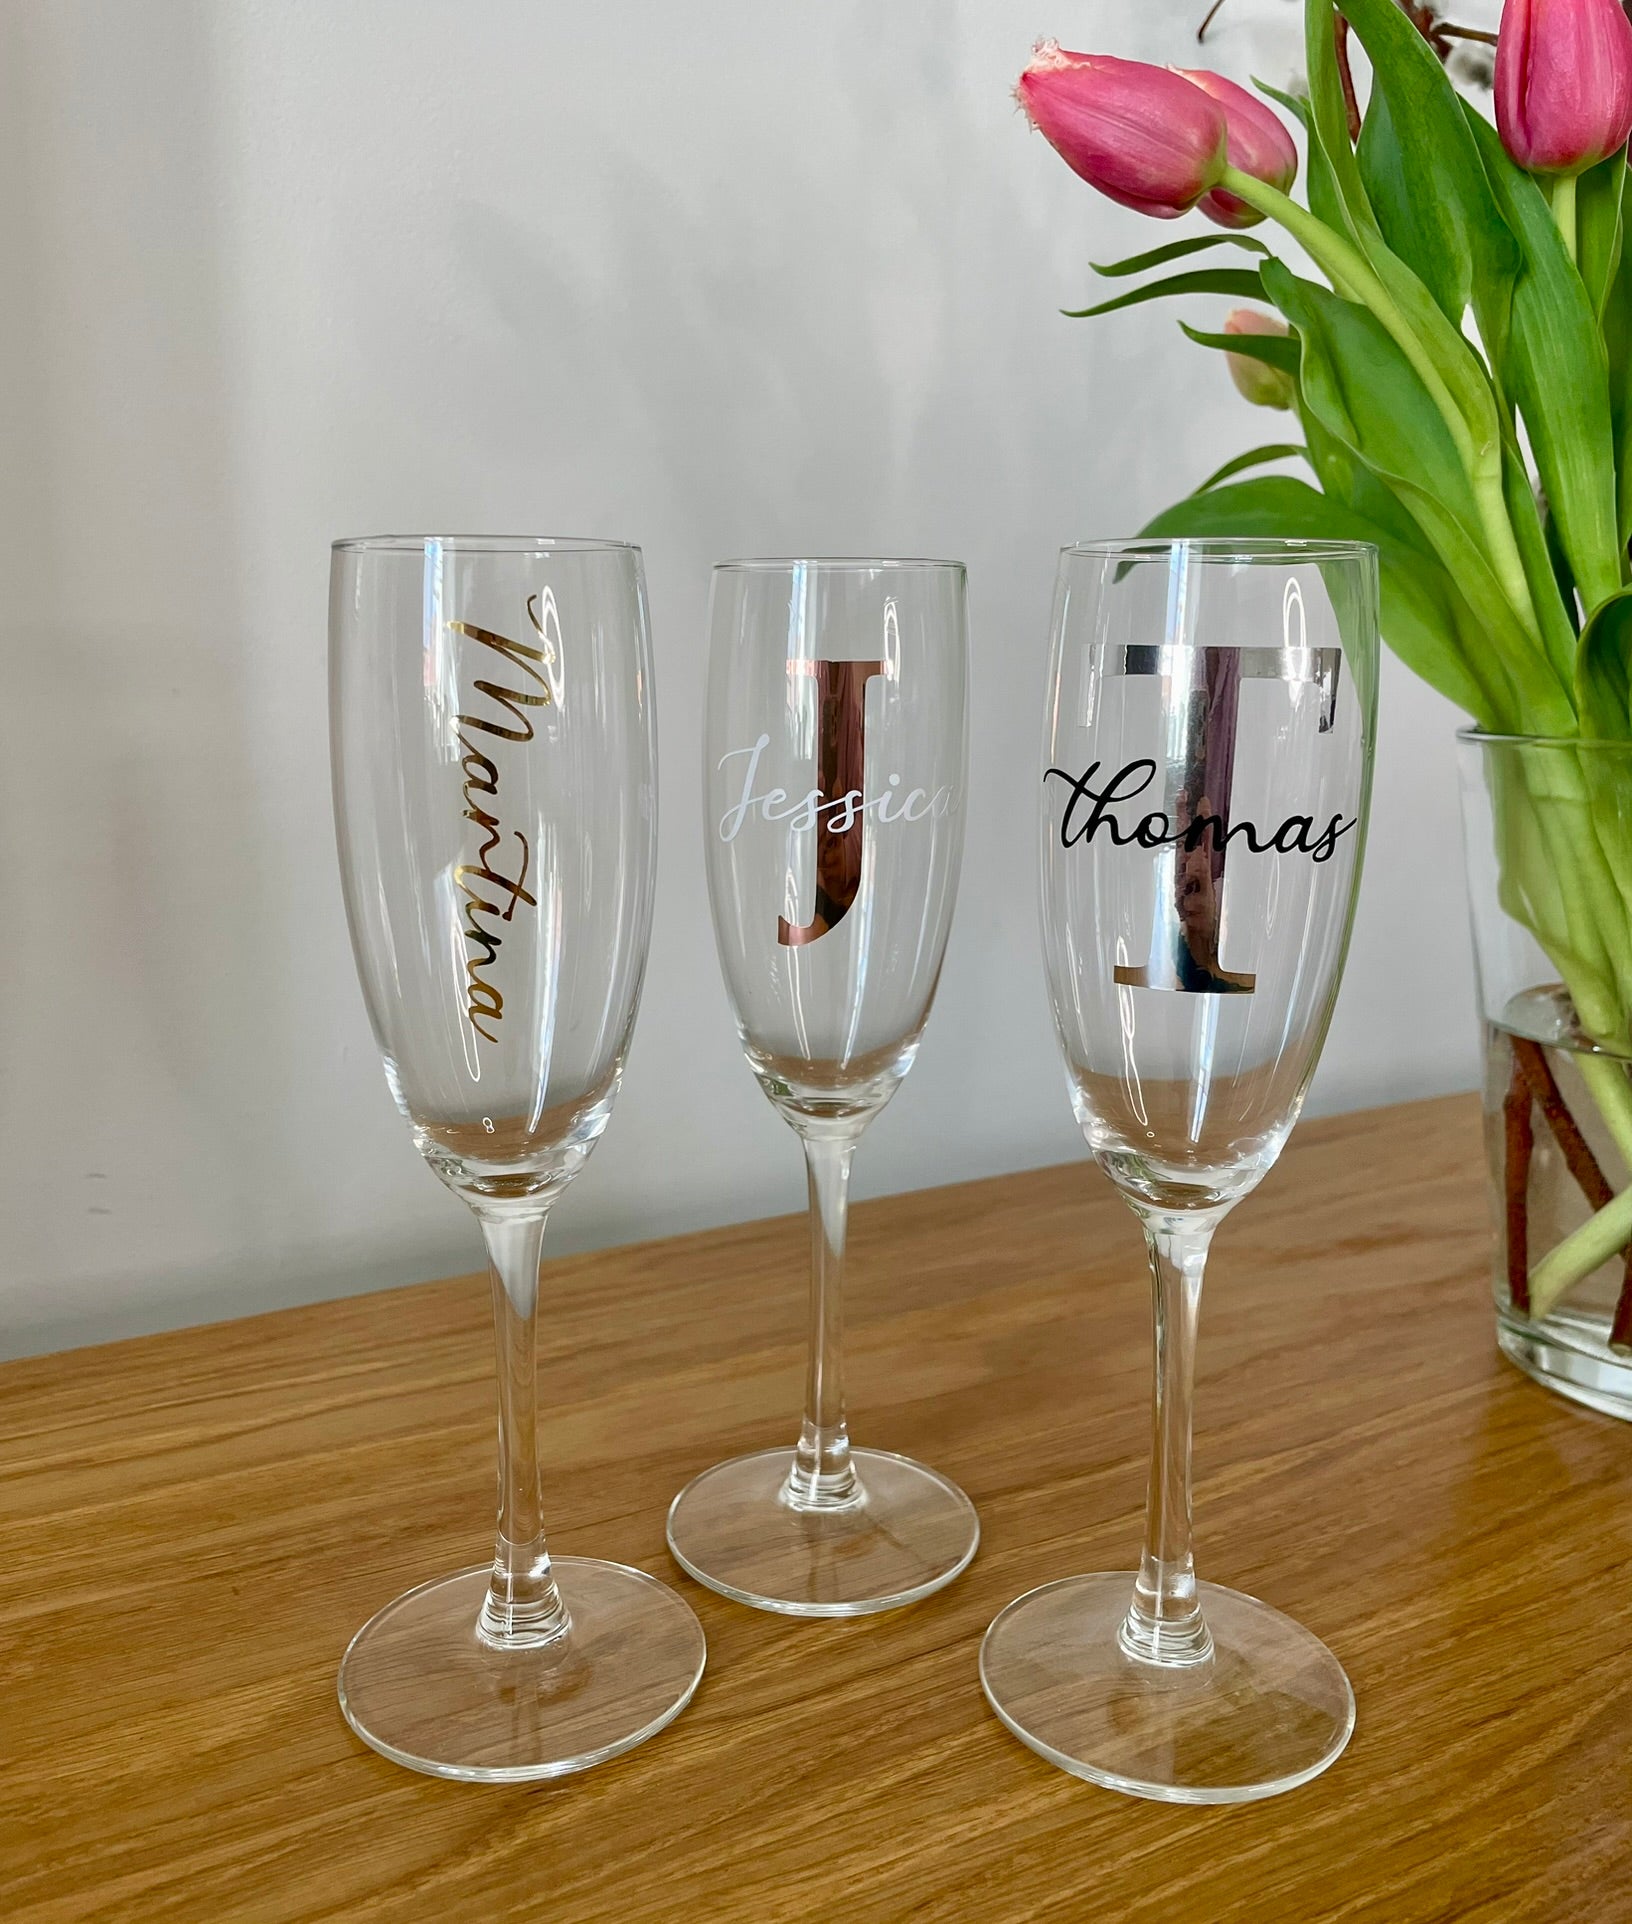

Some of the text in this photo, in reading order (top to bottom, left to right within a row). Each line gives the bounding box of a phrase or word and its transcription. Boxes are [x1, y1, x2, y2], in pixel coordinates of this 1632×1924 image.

[446, 595, 556, 1043] Martina
[778, 660, 891, 946] J
[1079, 645, 1341, 994] T
